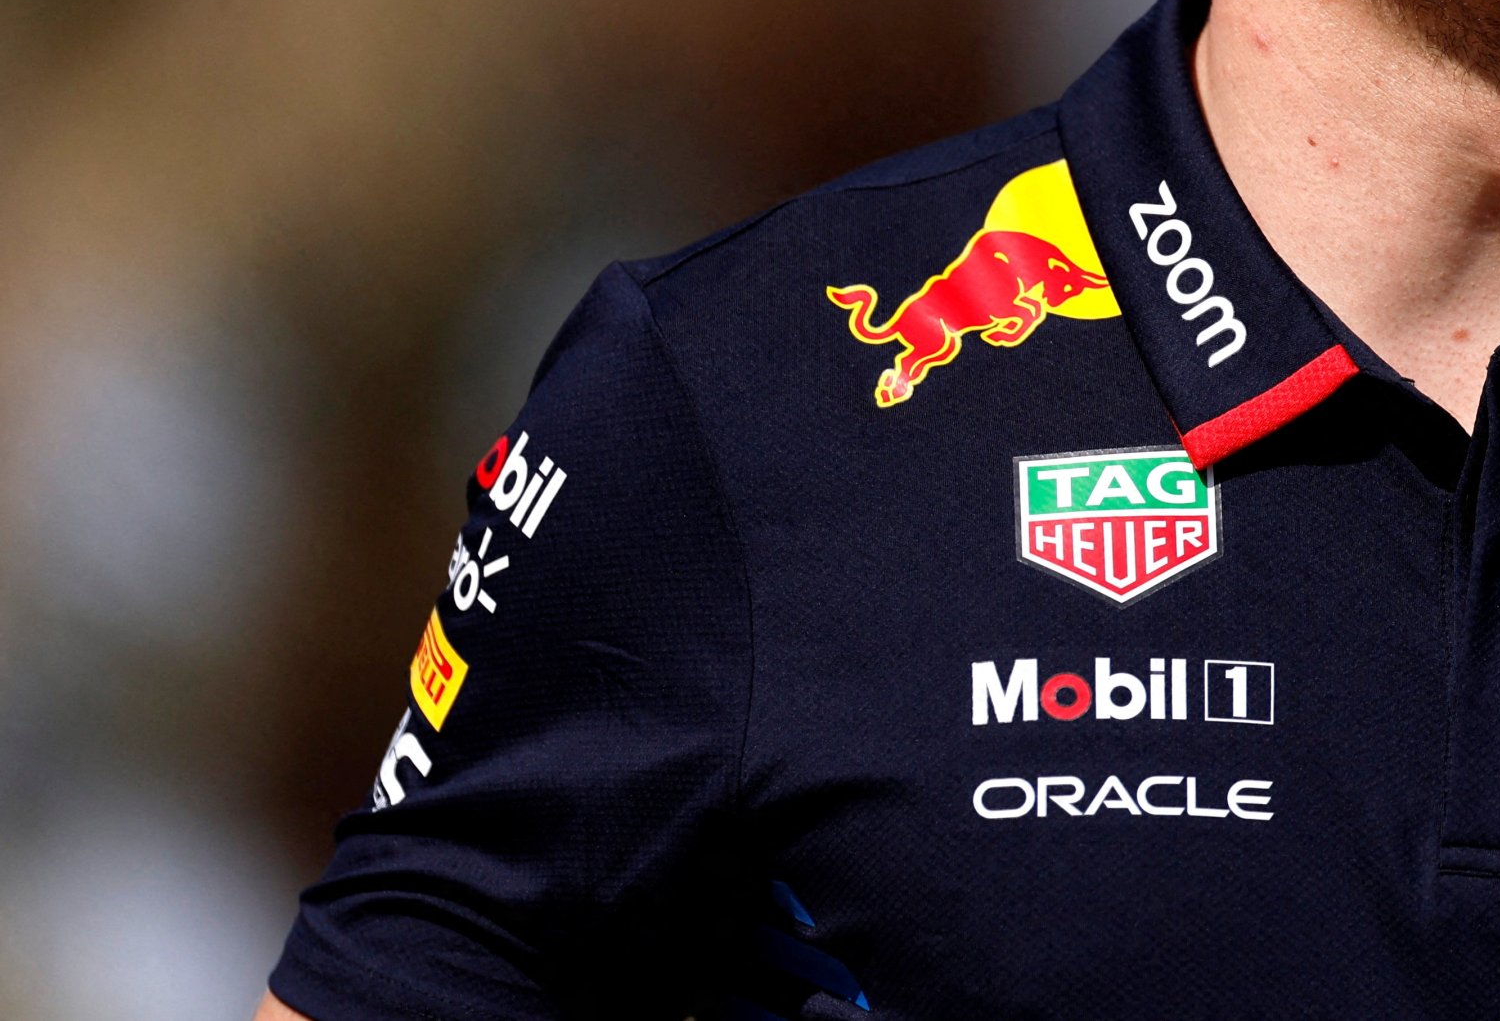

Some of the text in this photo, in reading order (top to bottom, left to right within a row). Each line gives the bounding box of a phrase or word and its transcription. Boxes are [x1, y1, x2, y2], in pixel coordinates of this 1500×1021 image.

[1128, 180, 1247, 368] zoom
[476, 430, 568, 539] obil
[1037, 461, 1196, 508] TAG
[1035, 520, 1203, 589] HEUER
[971, 656, 1249, 726] Mobil 1
[972, 774, 1275, 821] ORACLE
